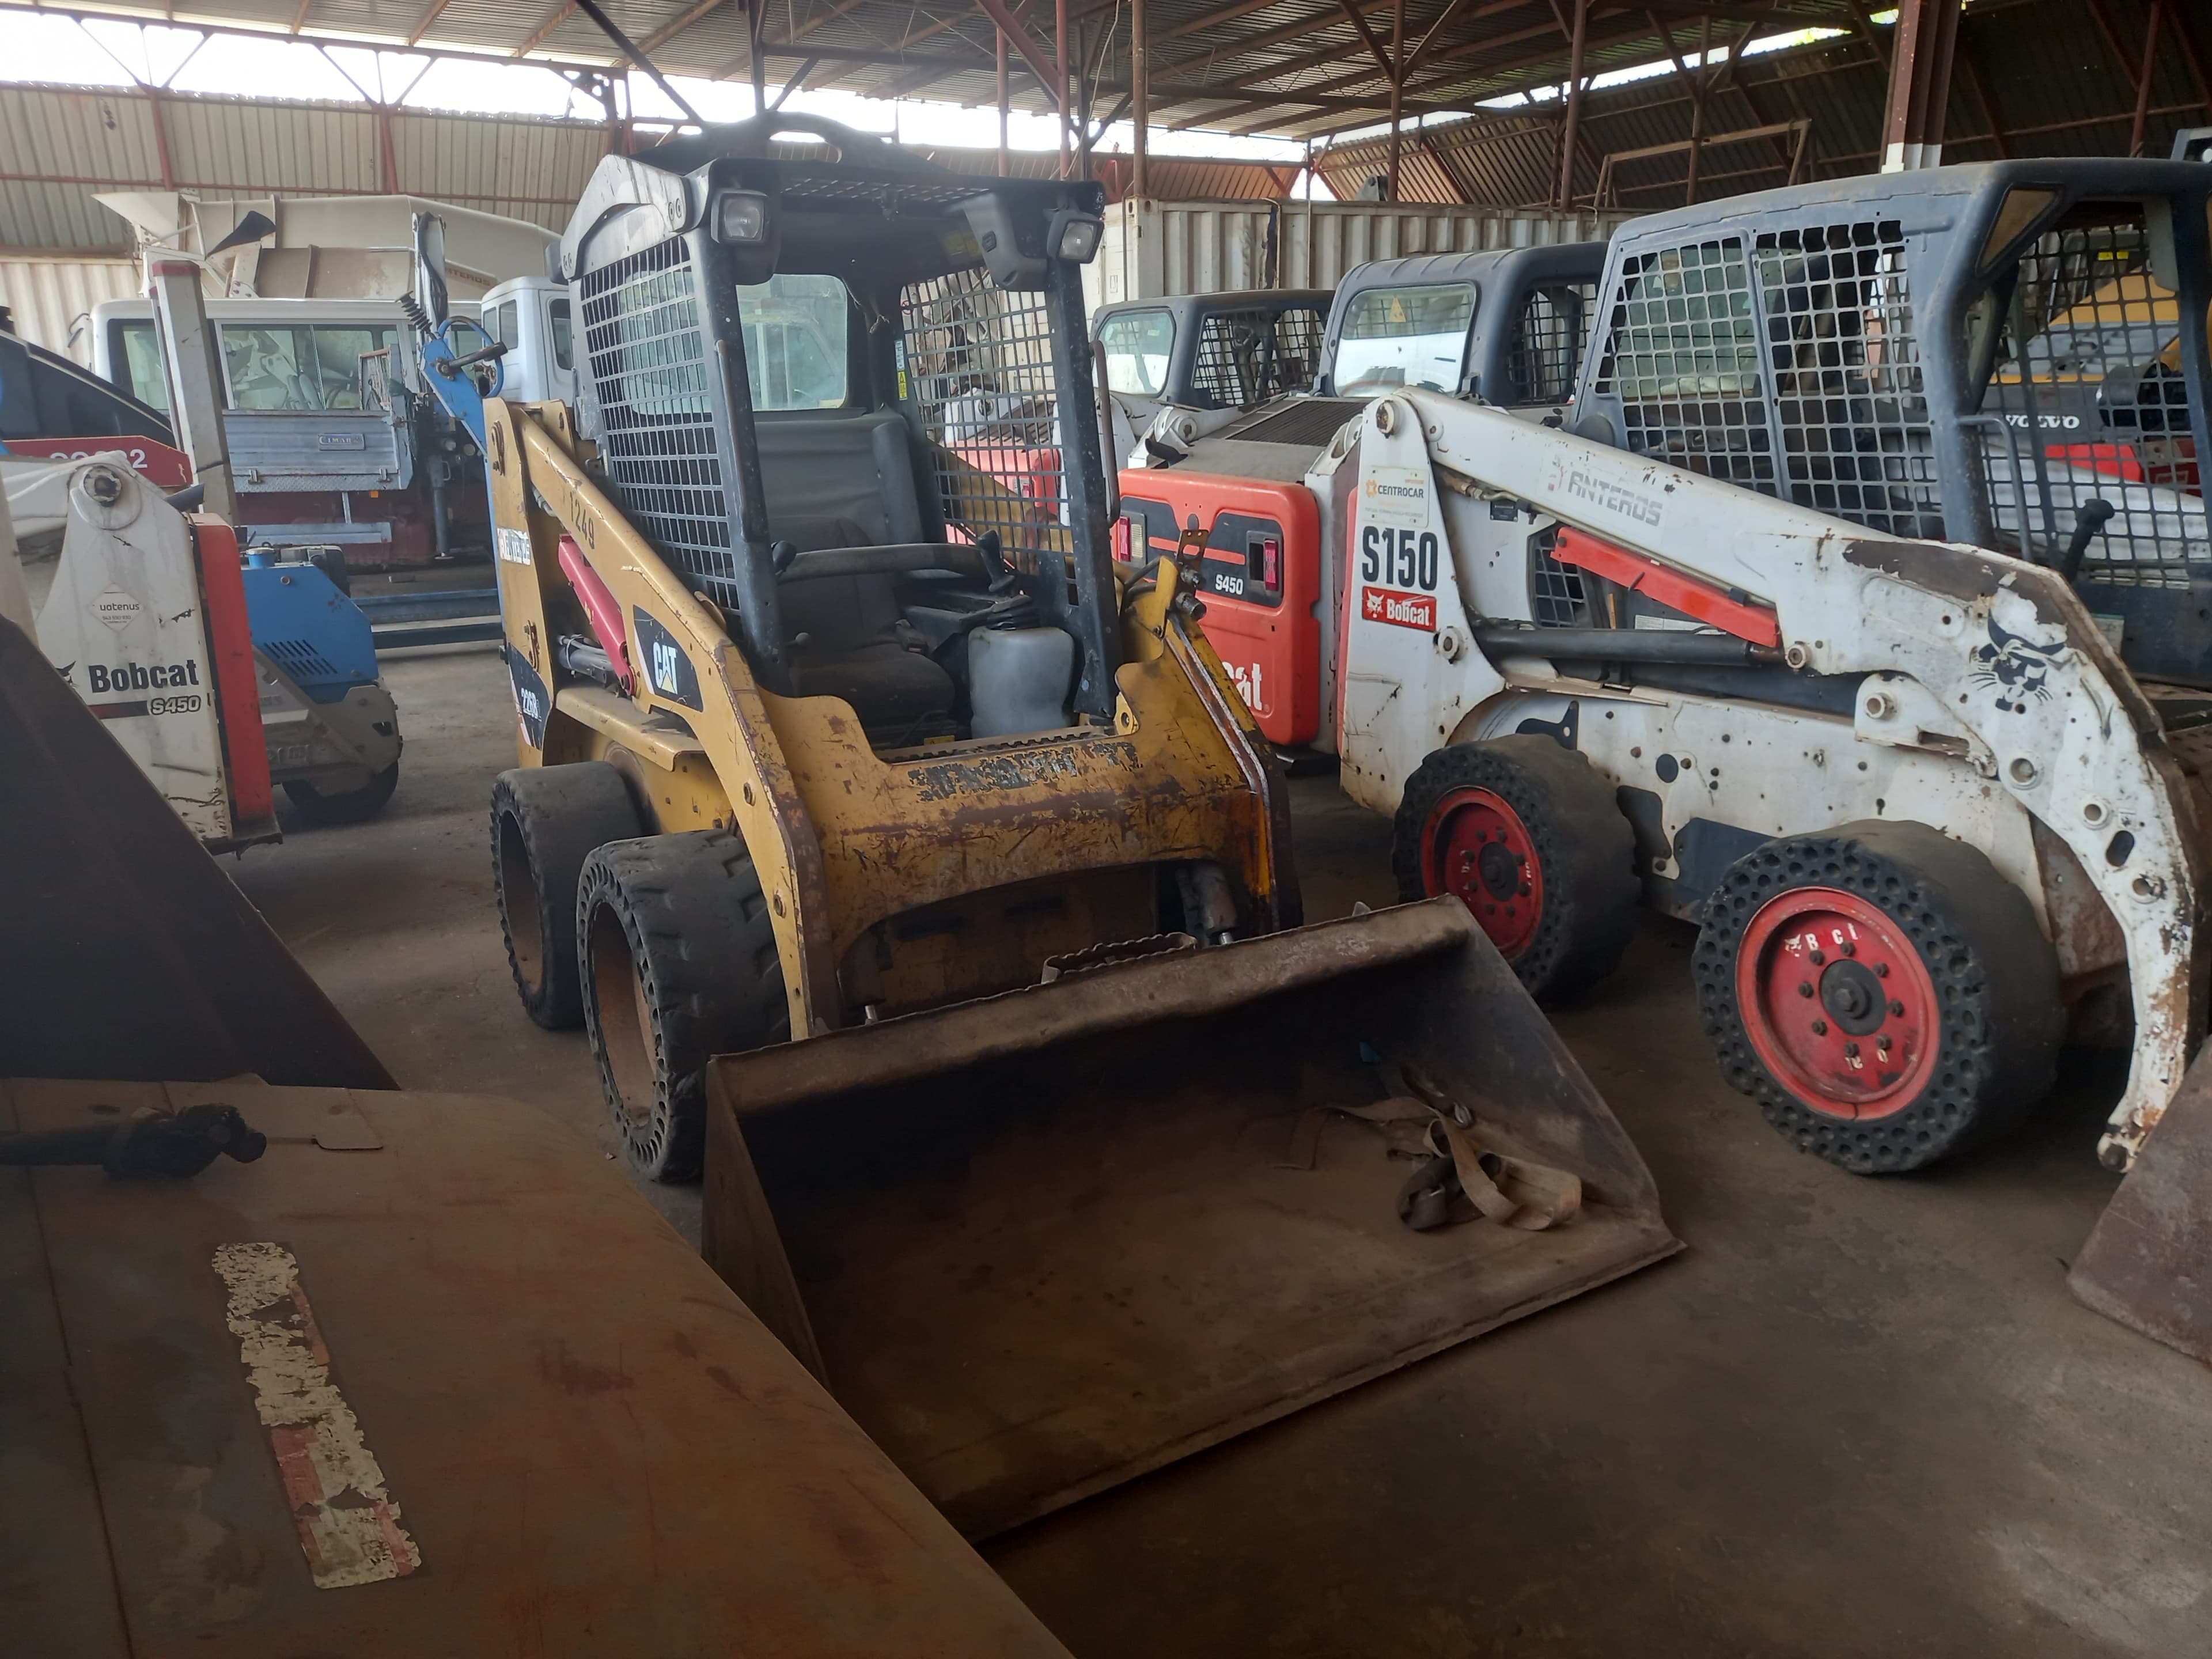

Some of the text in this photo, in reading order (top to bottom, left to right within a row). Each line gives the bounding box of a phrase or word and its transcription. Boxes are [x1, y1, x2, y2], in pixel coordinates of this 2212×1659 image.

[2005, 414, 2080, 429] VOLVO
[1378, 485, 1424, 499] CENTROCAR
[570, 491, 595, 550] 1249
[1362, 525, 1438, 591] S150
[1215, 574, 1244, 595] S450
[1386, 598, 1430, 626] Bobcat
[88, 659, 199, 694] Bobcat
[652, 641, 679, 695] CAT
[151, 695, 202, 715] S450
